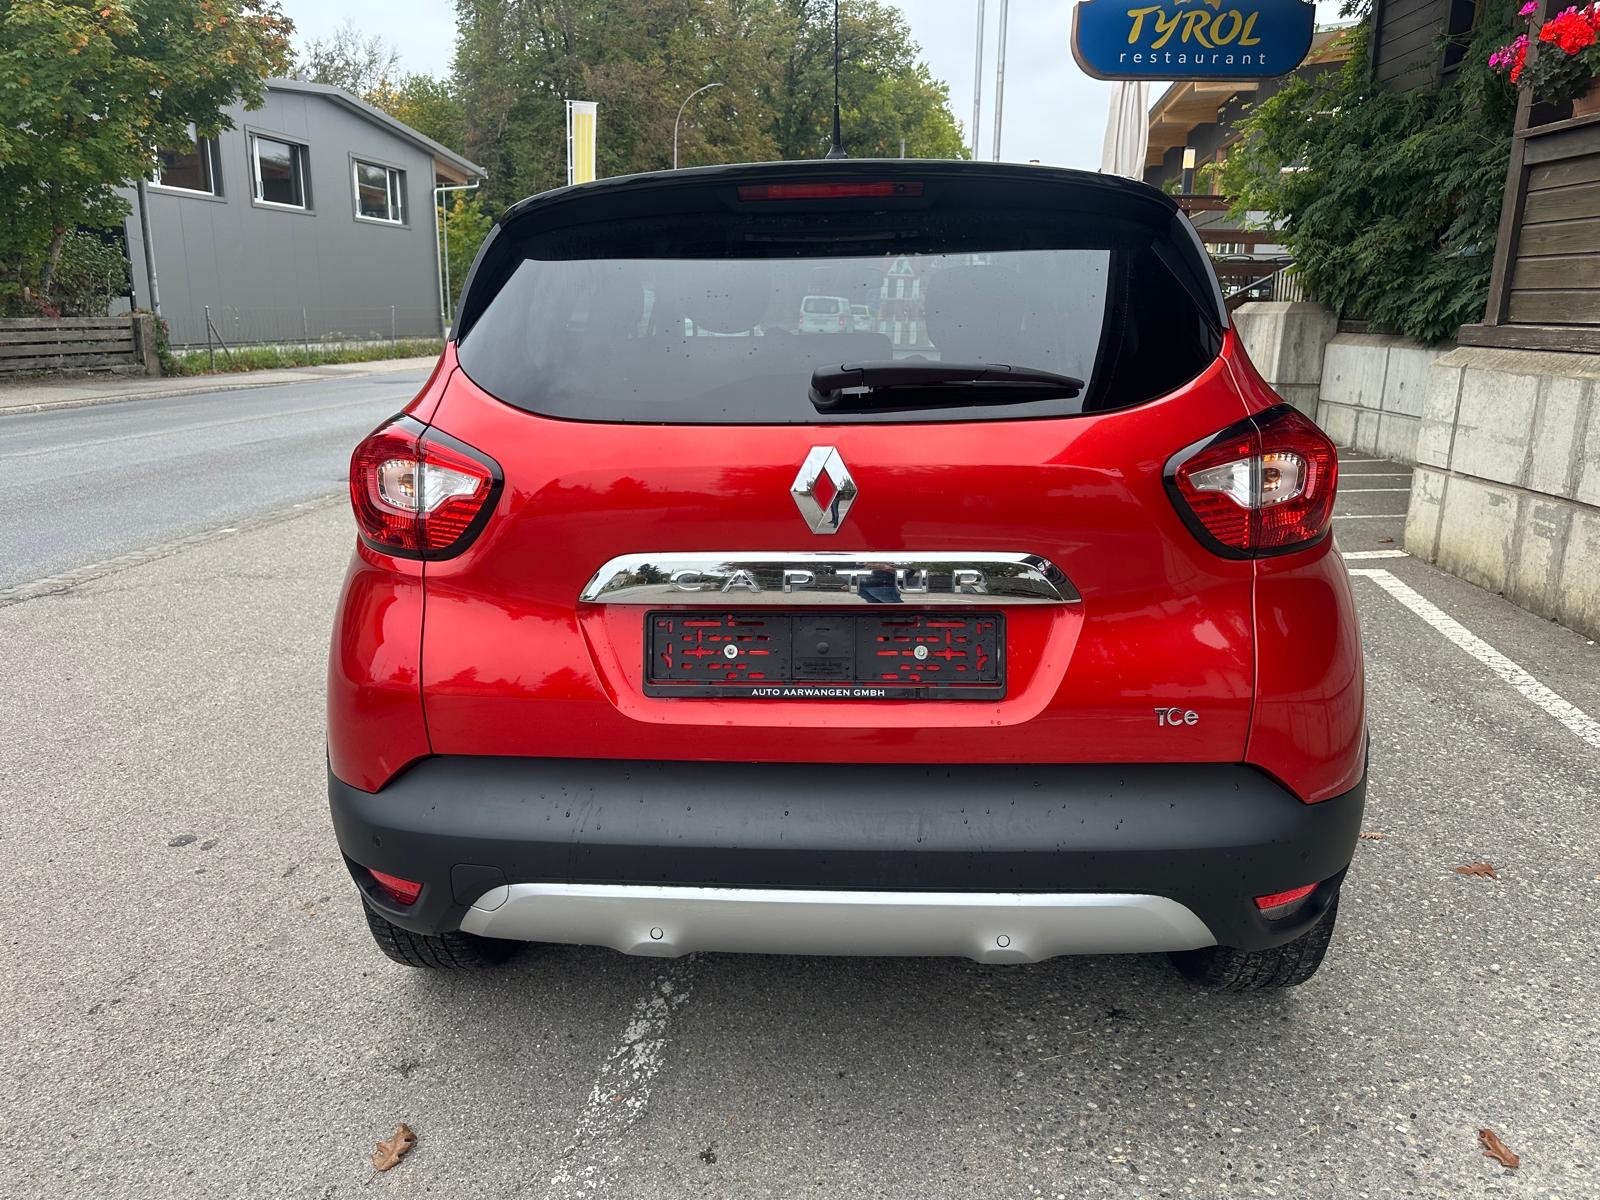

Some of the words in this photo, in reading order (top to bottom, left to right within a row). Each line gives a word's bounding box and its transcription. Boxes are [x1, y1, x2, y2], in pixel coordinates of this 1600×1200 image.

[1127, 5, 1261, 50] TYROL
[1119, 51, 1266, 65] restaurant
[670, 569, 989, 594] CAPTUR
[751, 688, 781, 696] AUTO
[783, 688, 851, 697] AARWANGEN
[853, 688, 885, 697] GMBH
[1153, 707, 1199, 727] TCe
